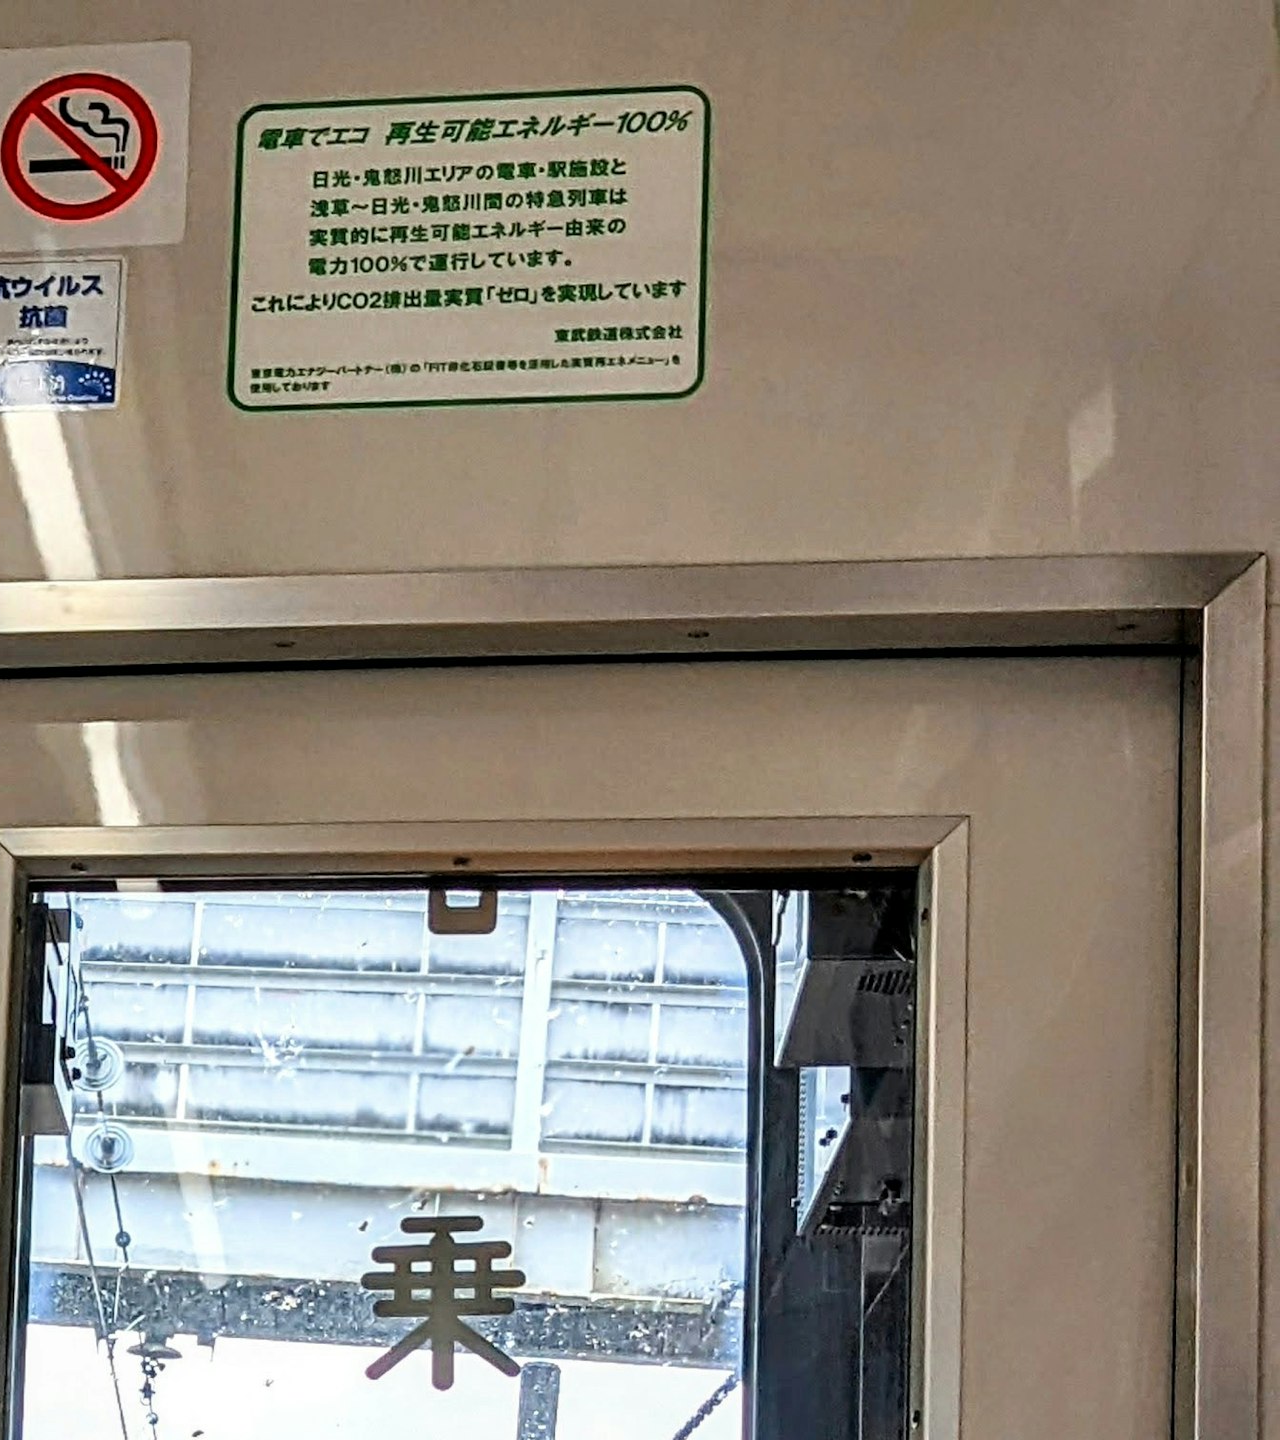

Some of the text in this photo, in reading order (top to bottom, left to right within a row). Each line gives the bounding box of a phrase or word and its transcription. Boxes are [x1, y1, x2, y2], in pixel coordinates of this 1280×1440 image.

[258, 110, 693, 150] 電車でエコ 再生可能エネルギー100%
[312, 159, 628, 189] 日光・鬼怒川エリアの電車・駅施設と
[308, 218, 627, 247] 実質的に再生可能エネルギー由来の
[308, 249, 574, 276] 電力100%で運行しています。
[19, 305, 67, 329] 抗菌
